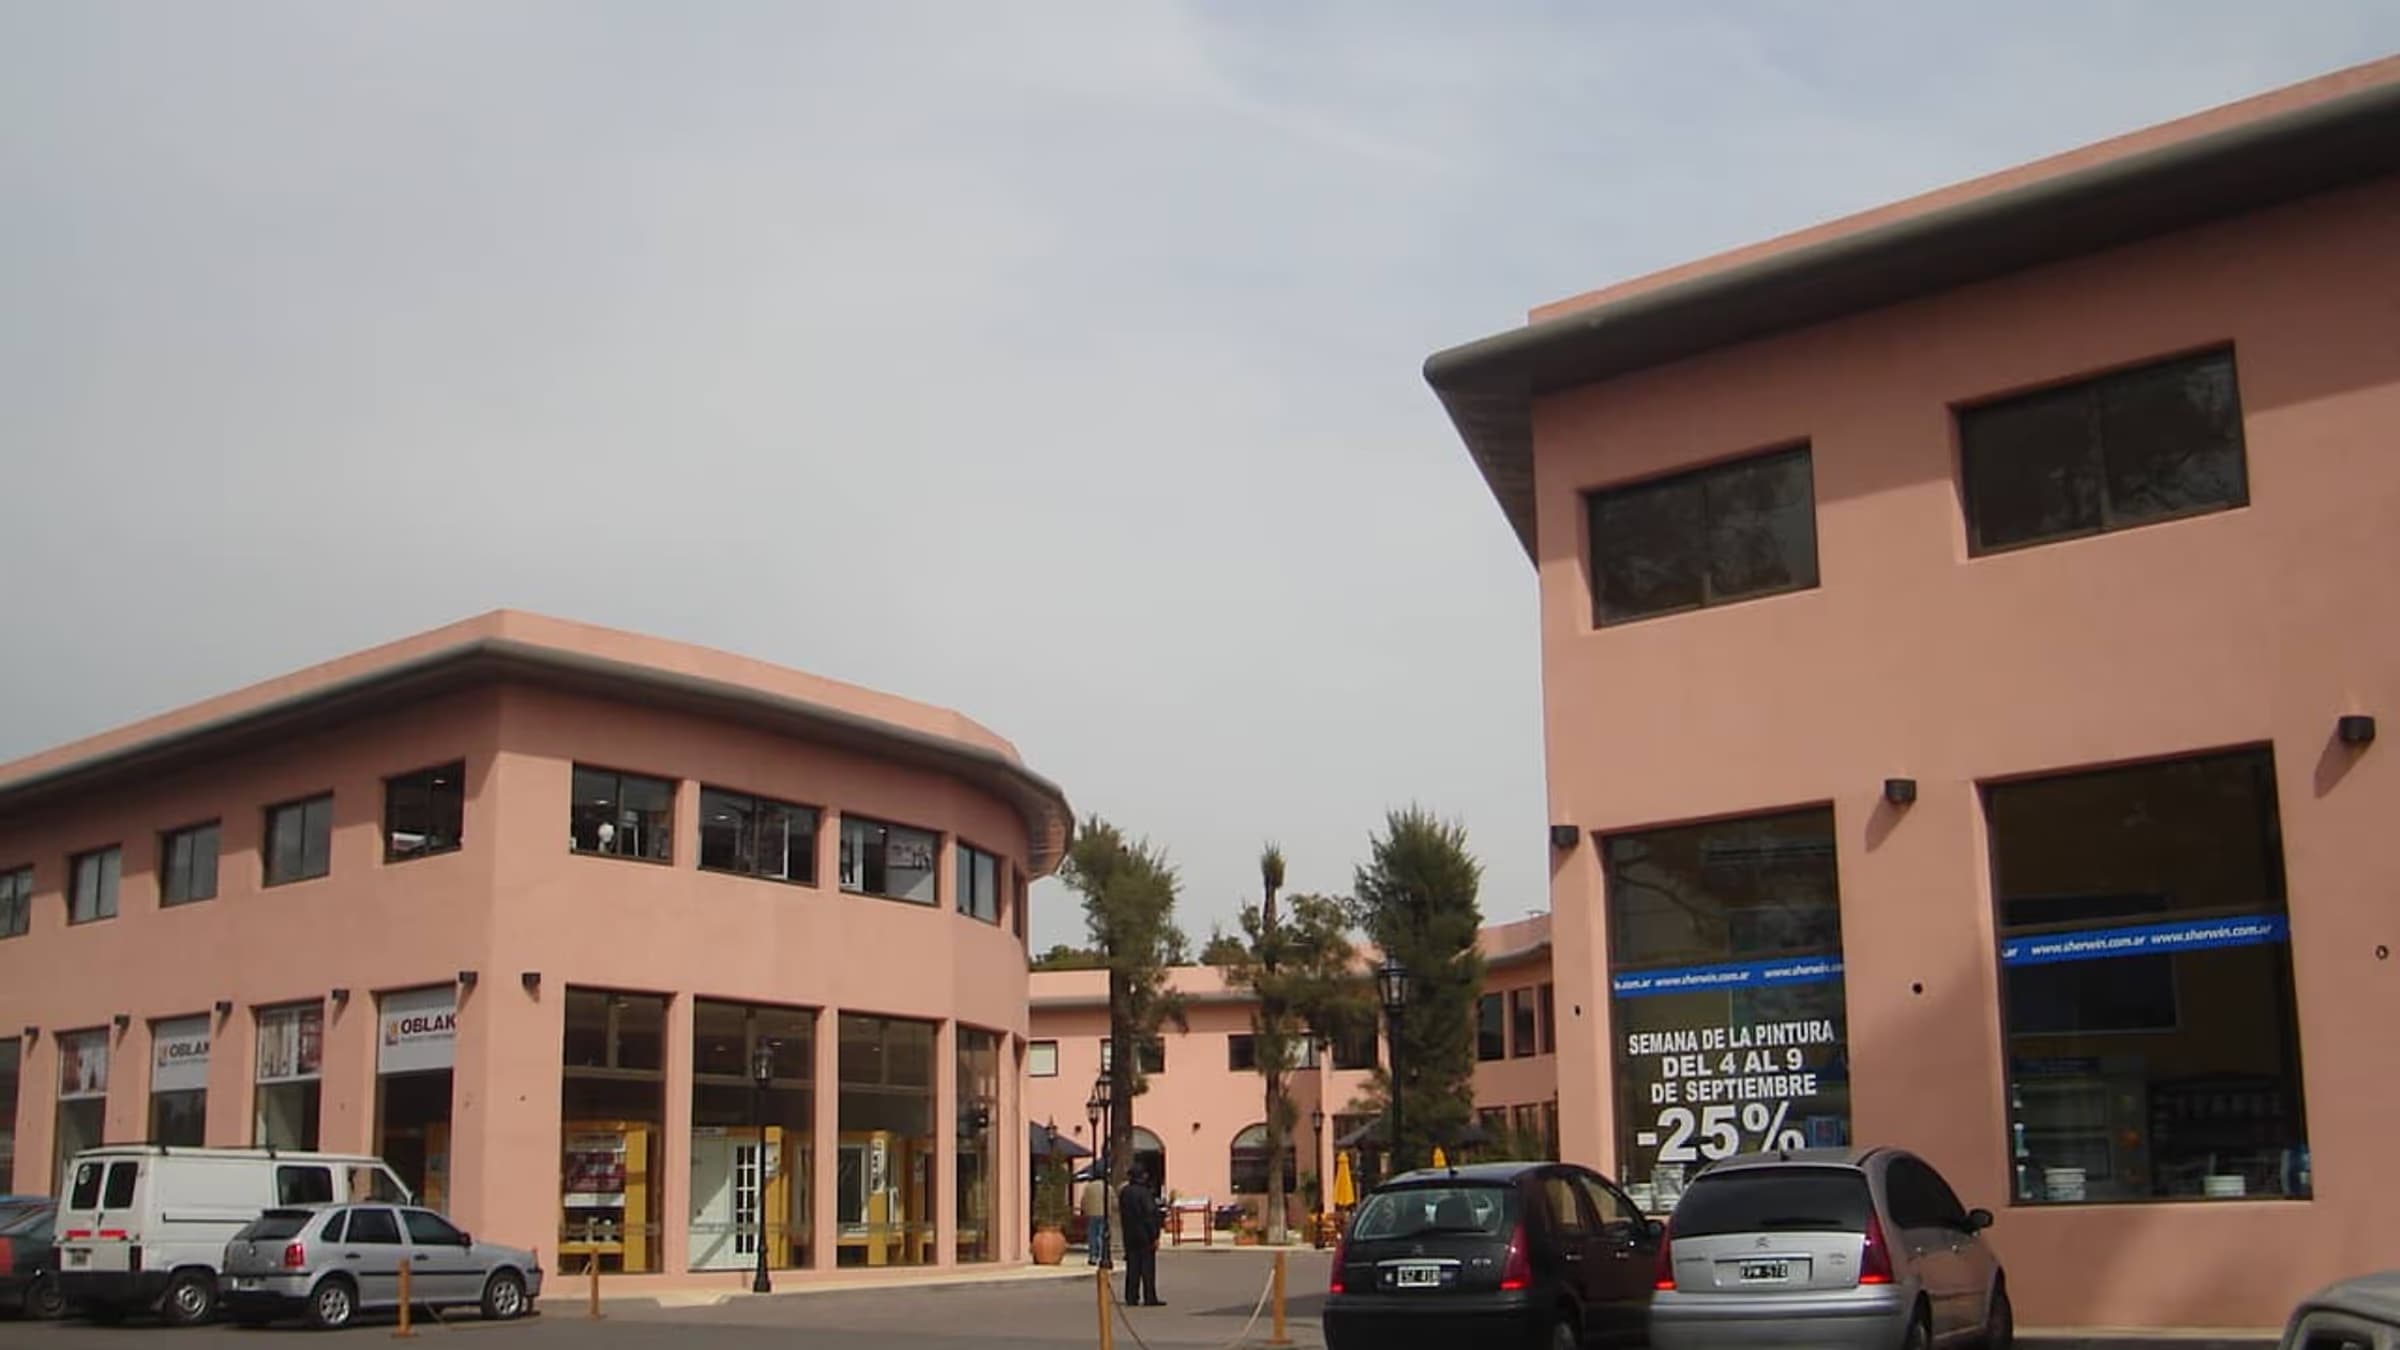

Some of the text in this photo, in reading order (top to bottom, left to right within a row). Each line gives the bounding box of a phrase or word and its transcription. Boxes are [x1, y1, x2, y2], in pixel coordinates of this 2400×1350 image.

[401, 1013, 456, 1034] OBLAK
[1629, 1020, 1835, 1054] SEMANA DE LA PINTURA
[1662, 1047, 1804, 1078] DEL 4 AL 9
[1651, 1074, 1817, 1104] DE SEPTIEMBRE
[1637, 1100, 1806, 1162] -25%
